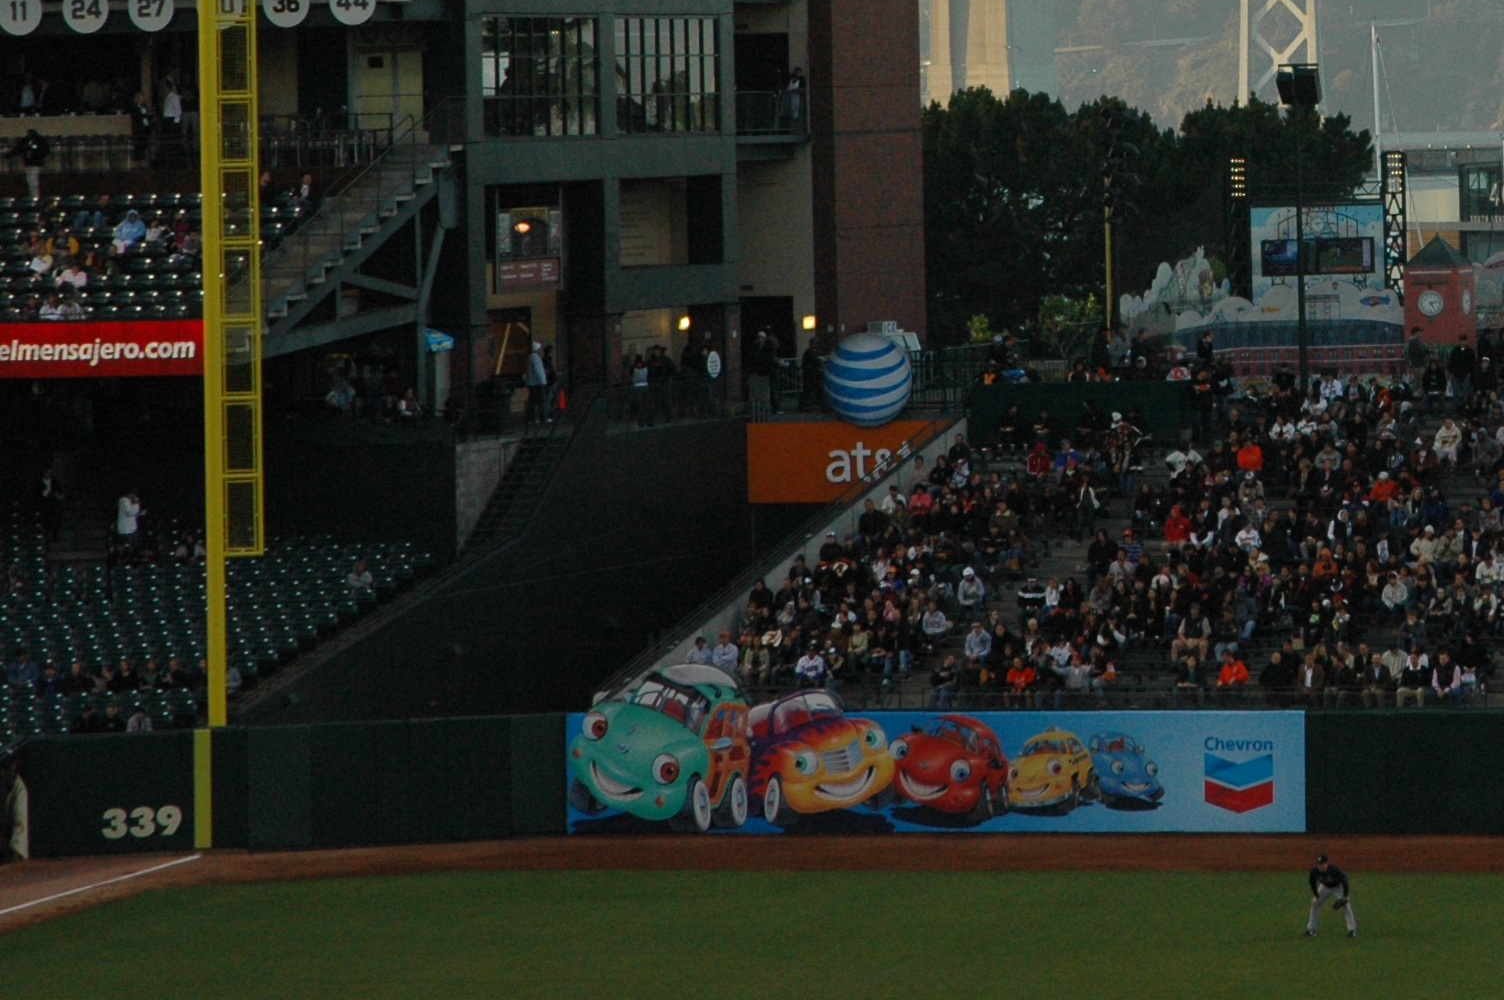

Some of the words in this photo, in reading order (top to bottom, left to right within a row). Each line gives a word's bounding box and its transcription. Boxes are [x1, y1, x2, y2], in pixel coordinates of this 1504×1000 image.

[9, 0, 27, 21] 11
[0, 338, 196, 367] elmensajero.com
[1203, 735, 1274, 752] Chevron
[102, 805, 183, 840] 339
